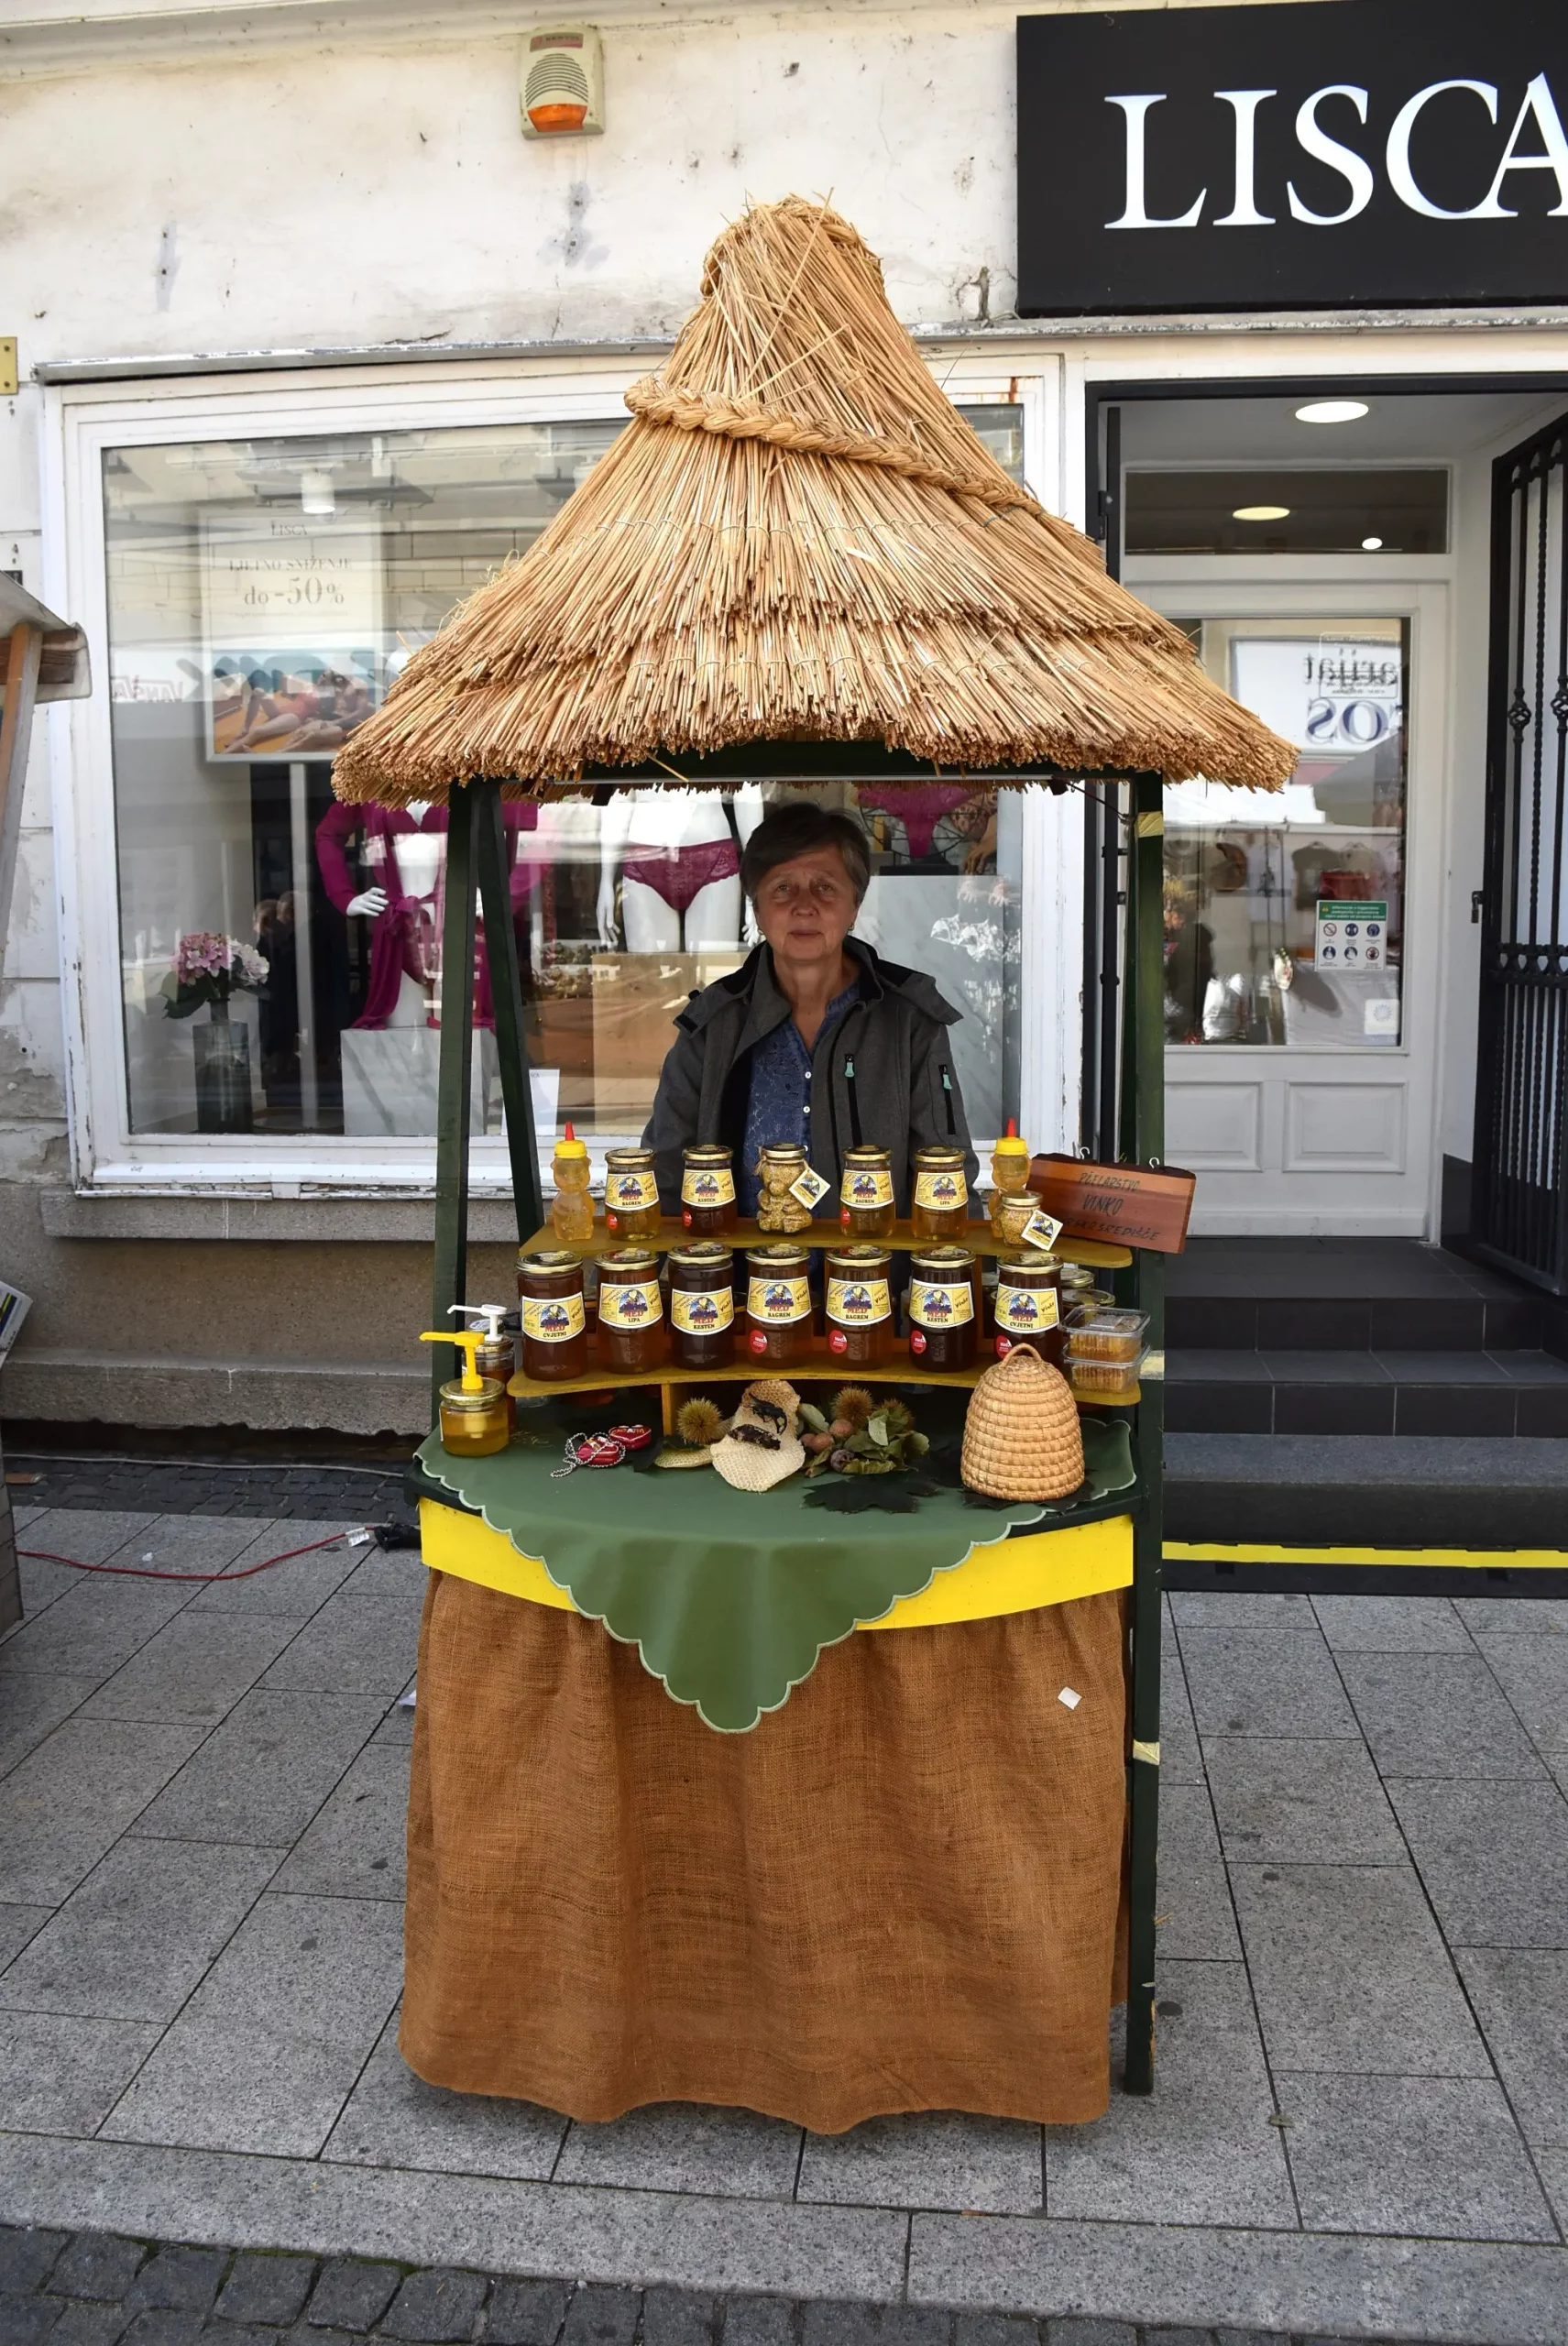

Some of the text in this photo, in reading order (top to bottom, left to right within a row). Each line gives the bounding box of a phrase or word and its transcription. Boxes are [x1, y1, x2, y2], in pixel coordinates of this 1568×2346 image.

[1103, 71, 1568, 230] LISCA
[244, 586, 269, 605] do
[1082, 1194, 1125, 1217] VINKO
